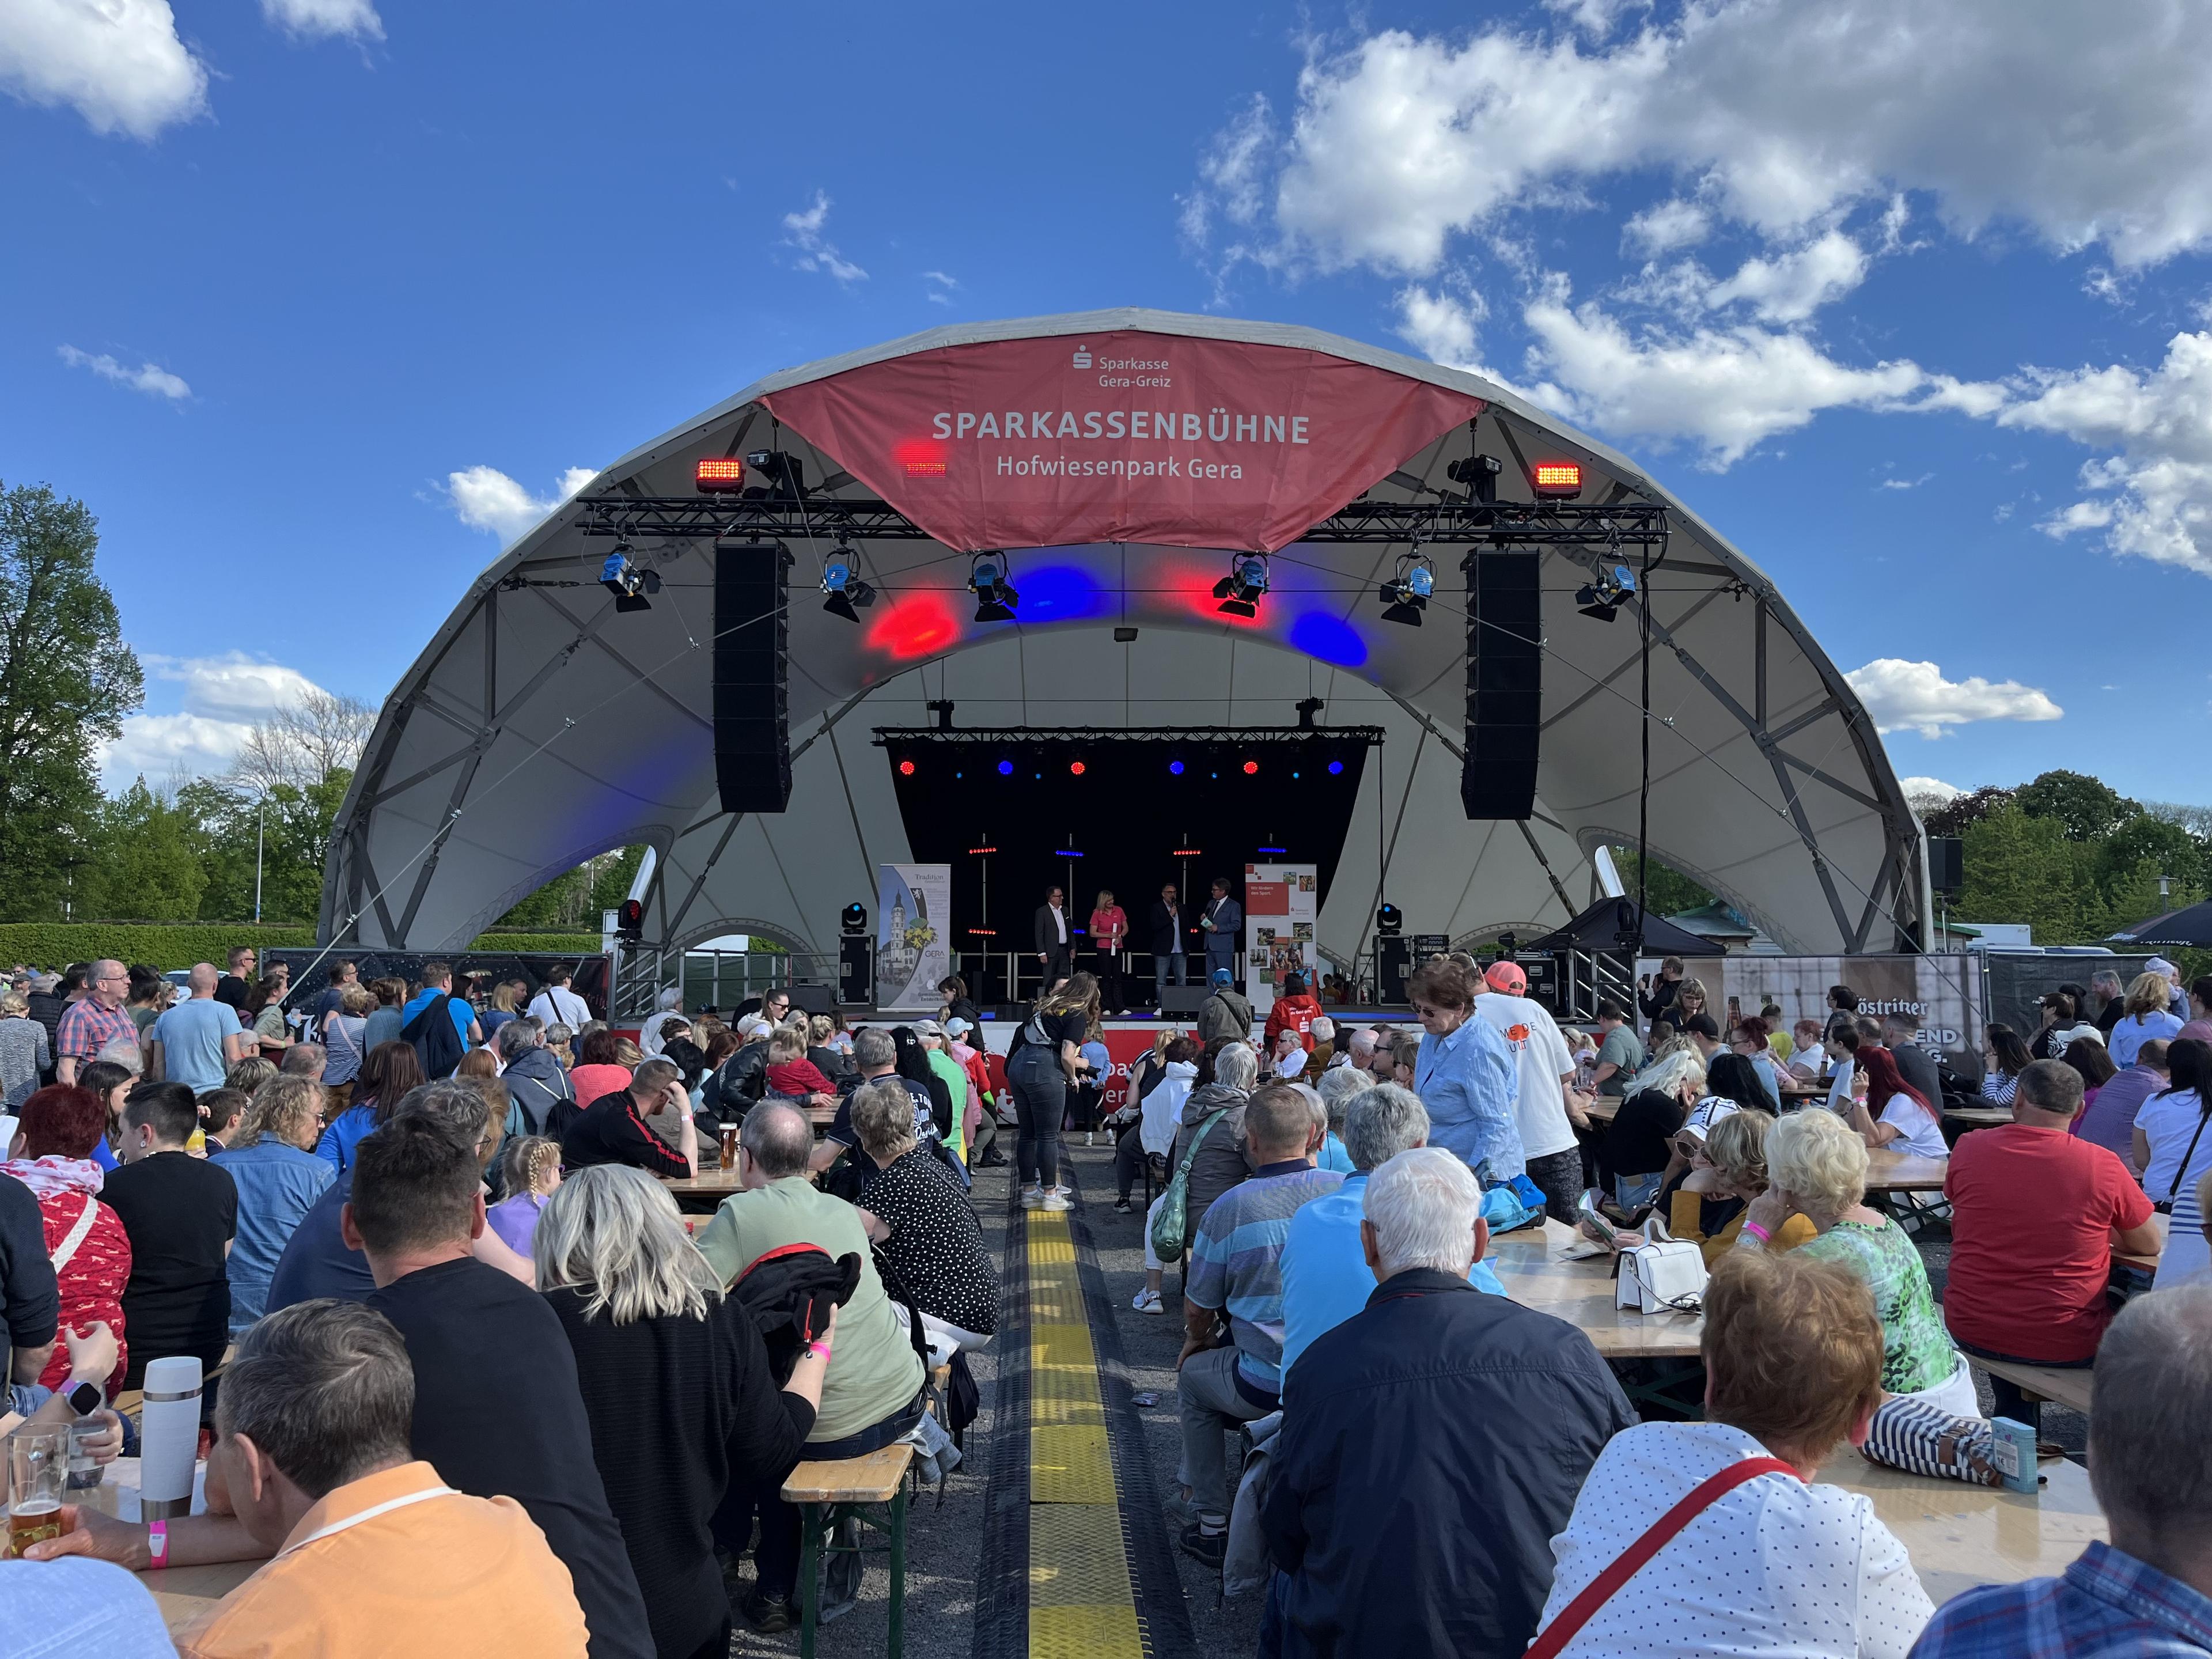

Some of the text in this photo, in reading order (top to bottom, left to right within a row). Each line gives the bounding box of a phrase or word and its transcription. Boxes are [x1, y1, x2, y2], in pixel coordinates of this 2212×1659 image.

[1099, 357, 1169, 372] Sparkasse
[1099, 375, 1171, 388] Gera-Greiz
[932, 407, 1309, 444] SPARKASSENBÜHNE
[997, 454, 1243, 480] Hofwiesenpark Gera
[1858, 997, 1929, 1016] östritzer
[1499, 1022, 1536, 1037] ME DE
[1915, 1029, 1957, 1043] END
[1509, 1040, 1527, 1052] UIT
